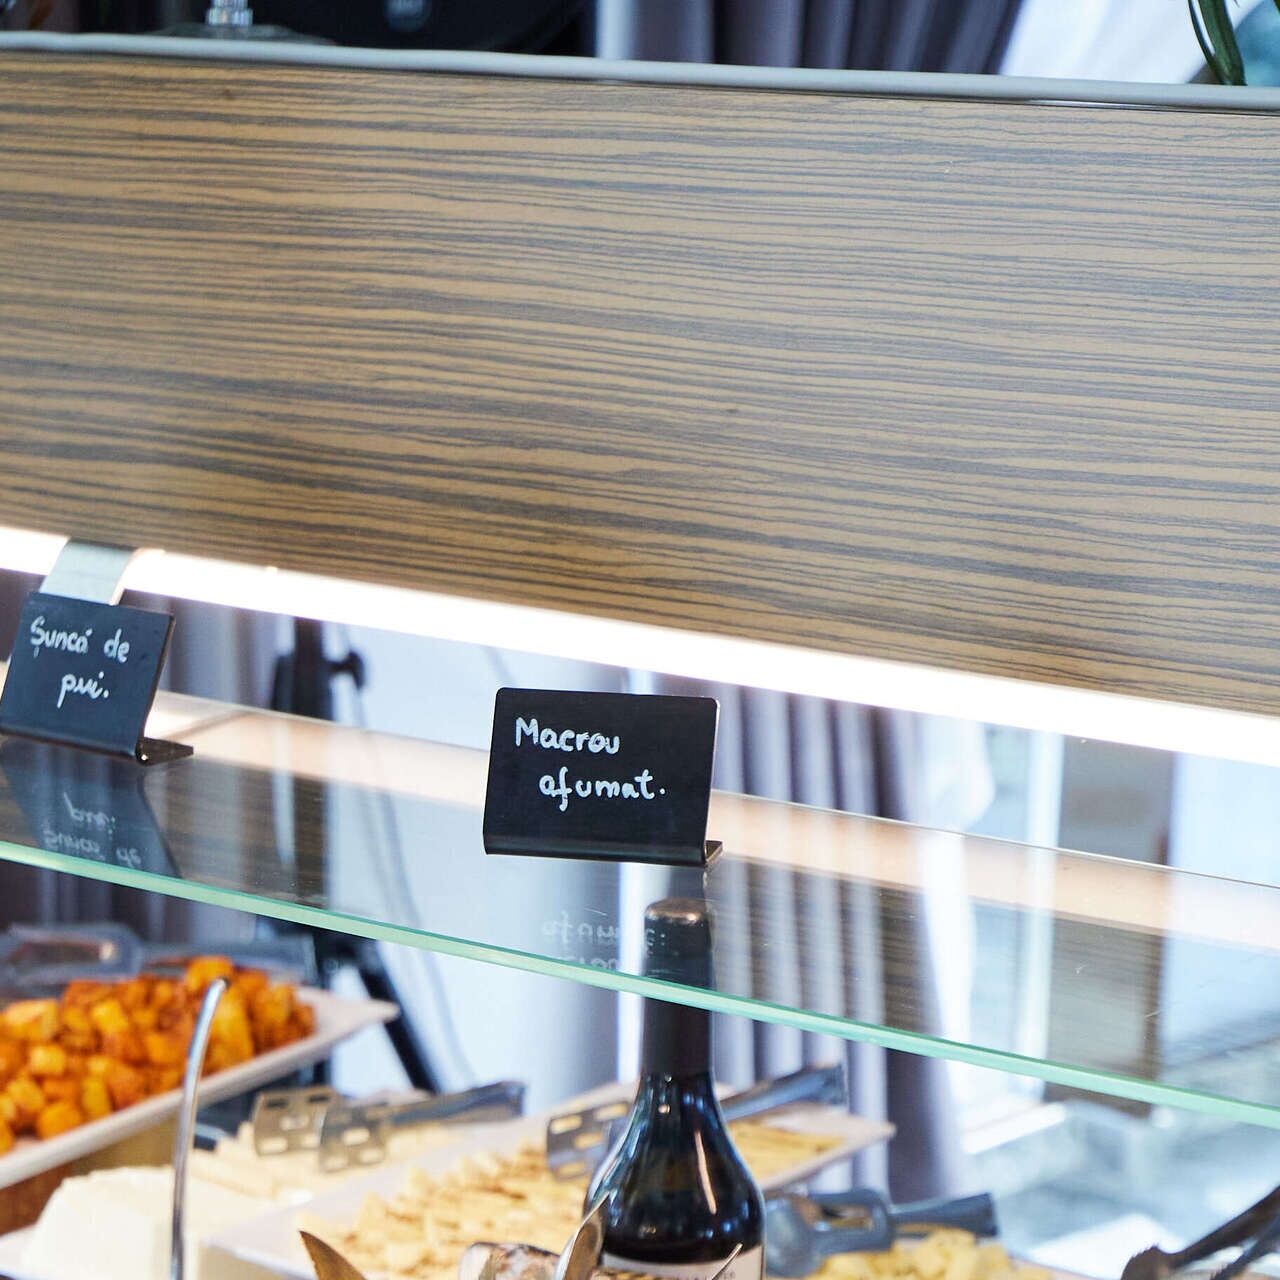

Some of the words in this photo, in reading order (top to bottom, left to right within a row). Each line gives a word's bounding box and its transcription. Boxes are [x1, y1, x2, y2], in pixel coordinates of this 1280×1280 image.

[104, 628, 130, 663] de
[57, 671, 109, 708] pui.
[515, 717, 620, 754] Macrou
[539, 766, 666, 812] afumat.
